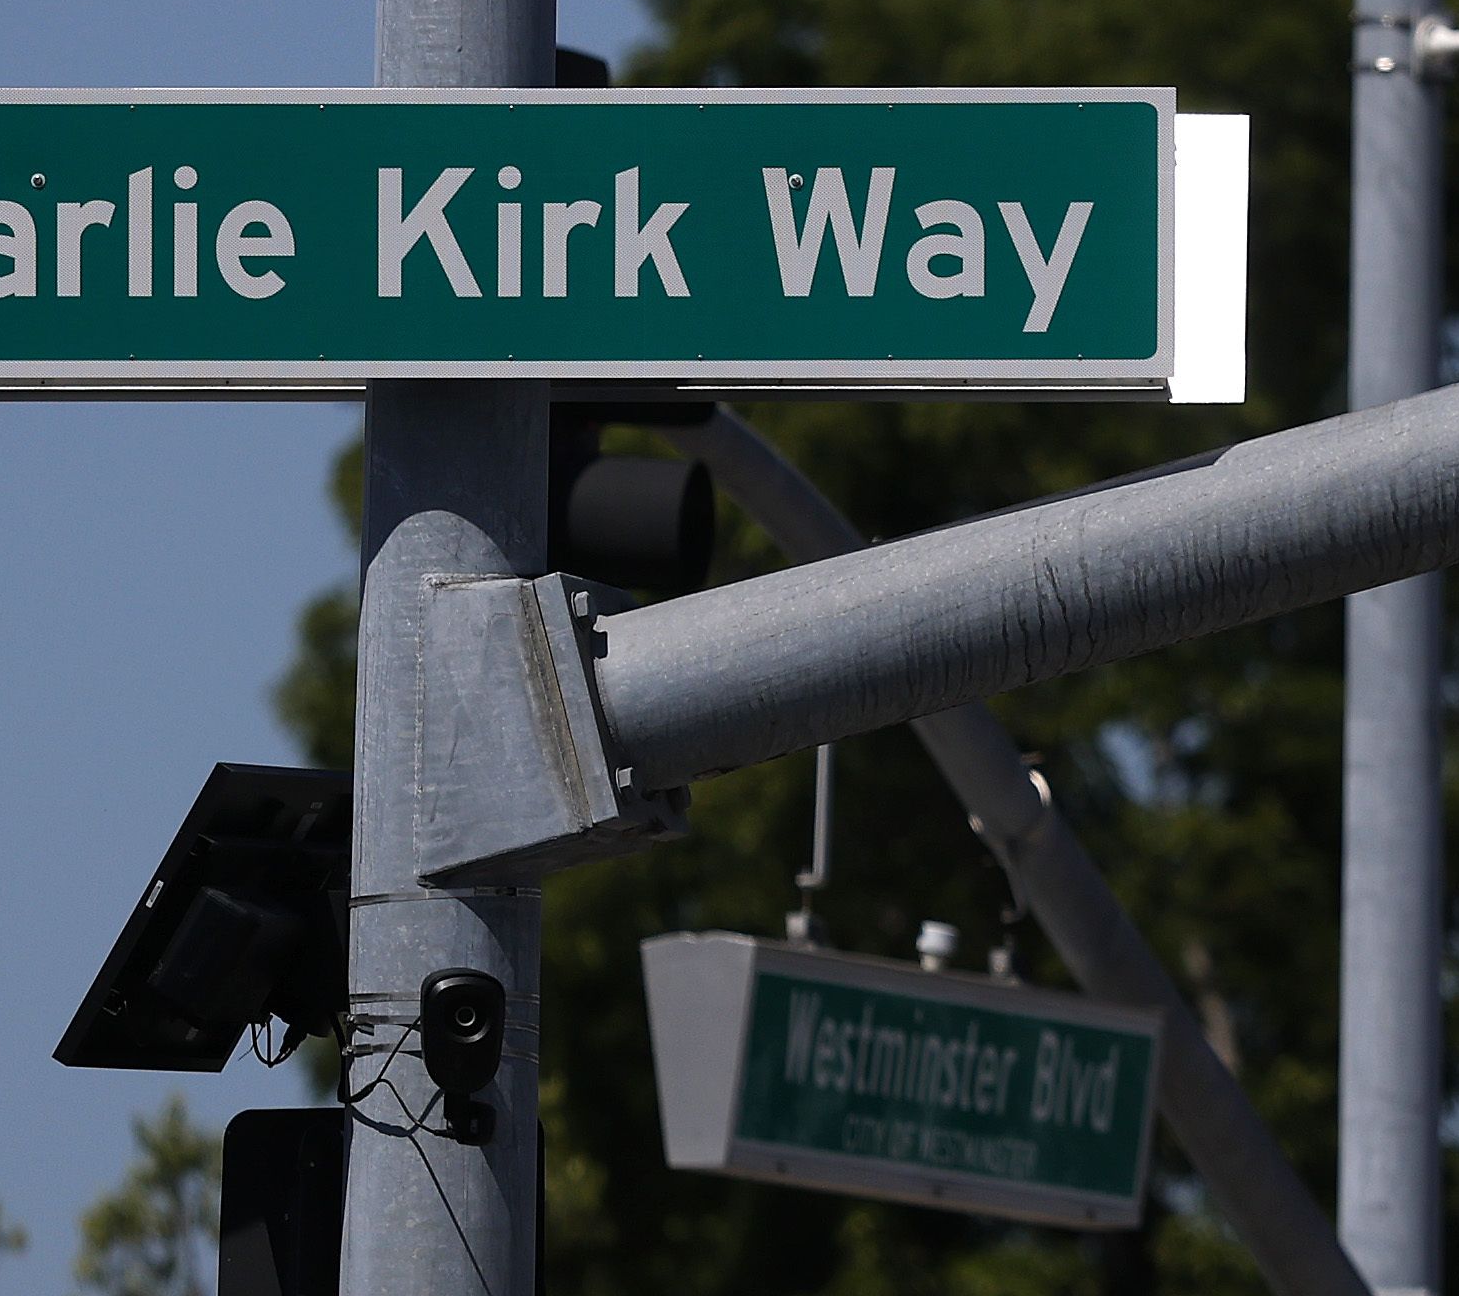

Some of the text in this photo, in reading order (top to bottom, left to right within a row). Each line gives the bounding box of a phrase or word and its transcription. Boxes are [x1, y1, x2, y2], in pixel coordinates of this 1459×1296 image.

[378, 166, 691, 298] Kirk
[762, 168, 1094, 332] Way
[784, 988, 1120, 1133] Westminster Blvd
